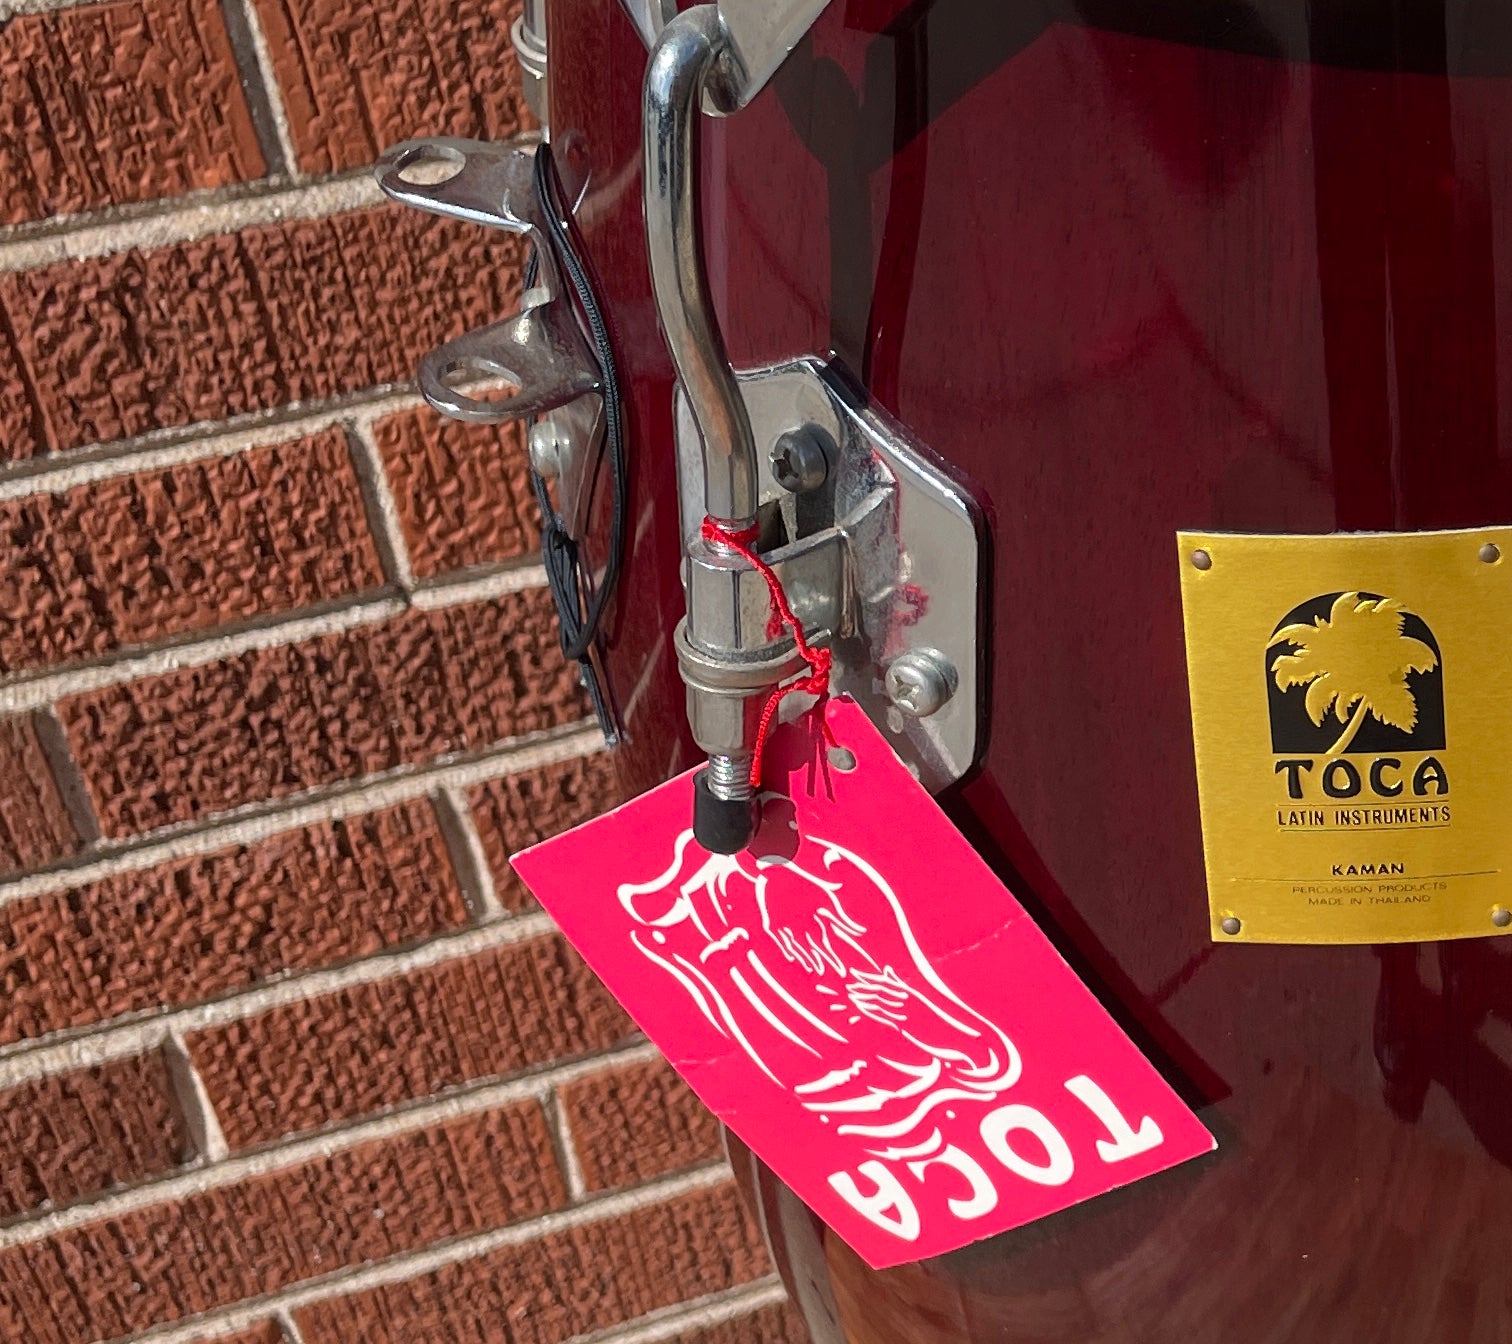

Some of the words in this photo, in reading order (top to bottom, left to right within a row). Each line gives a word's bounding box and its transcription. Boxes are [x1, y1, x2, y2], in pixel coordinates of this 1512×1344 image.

[1274, 756, 1449, 799] TOCA
[1277, 810, 1324, 826] LATIN
[1335, 806, 1450, 825] INSTRUMENTS
[1332, 862, 1405, 876] KAMAN
[1292, 884, 1373, 894] PERCUSSION
[1378, 881, 1448, 893] PRODUCTS
[1308, 896, 1343, 906] MADE
[1350, 897, 1362, 905] IN
[1368, 894, 1431, 905] THAILAND
[826, 1074, 1164, 1242] TOCA
